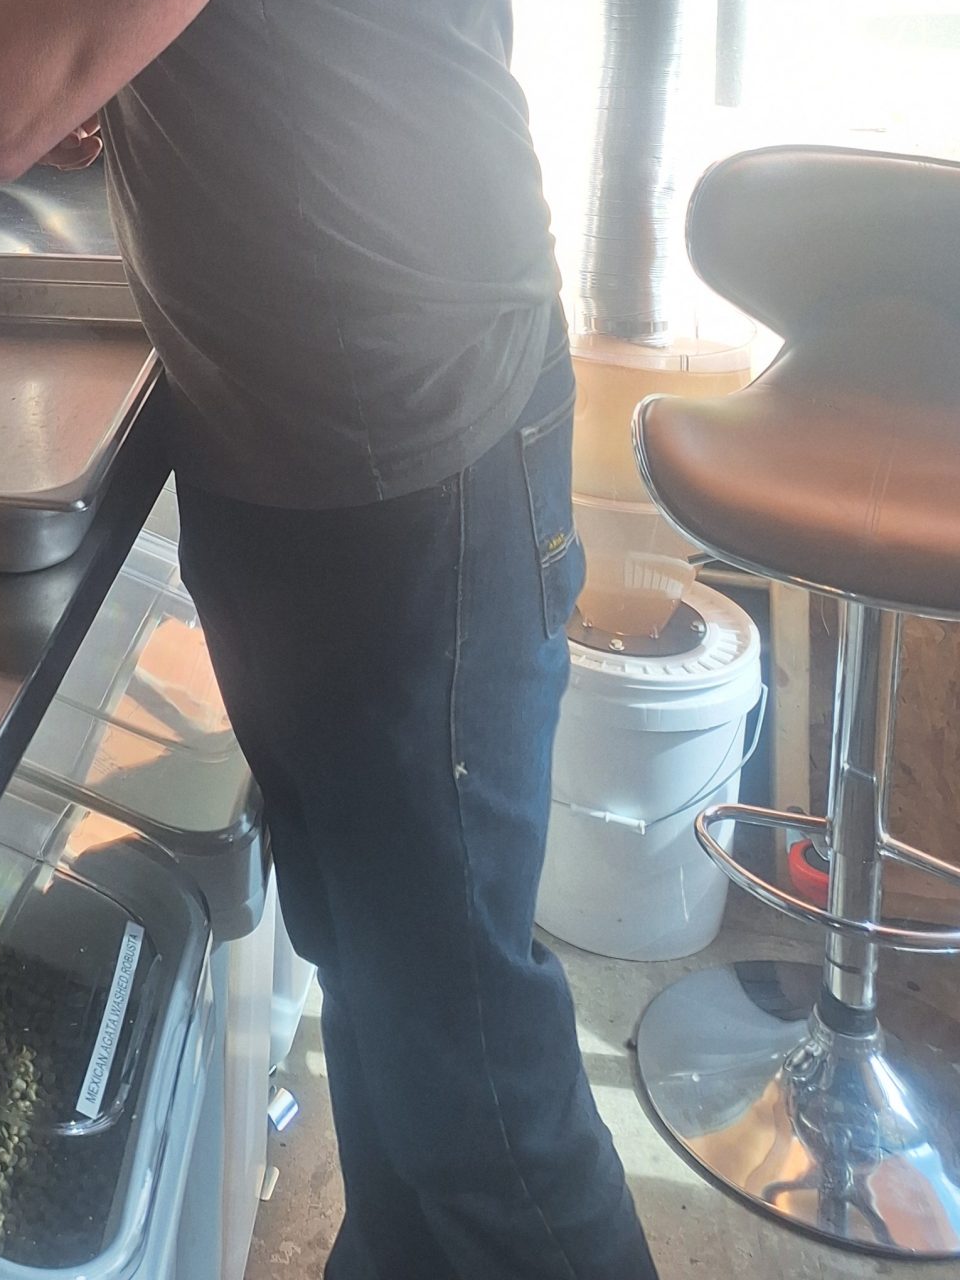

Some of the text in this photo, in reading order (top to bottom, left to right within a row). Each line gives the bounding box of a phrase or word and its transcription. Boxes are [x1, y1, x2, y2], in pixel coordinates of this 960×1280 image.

[85, 934, 138, 1104] MEXICAN AGATA WASHED ROBUSTA
